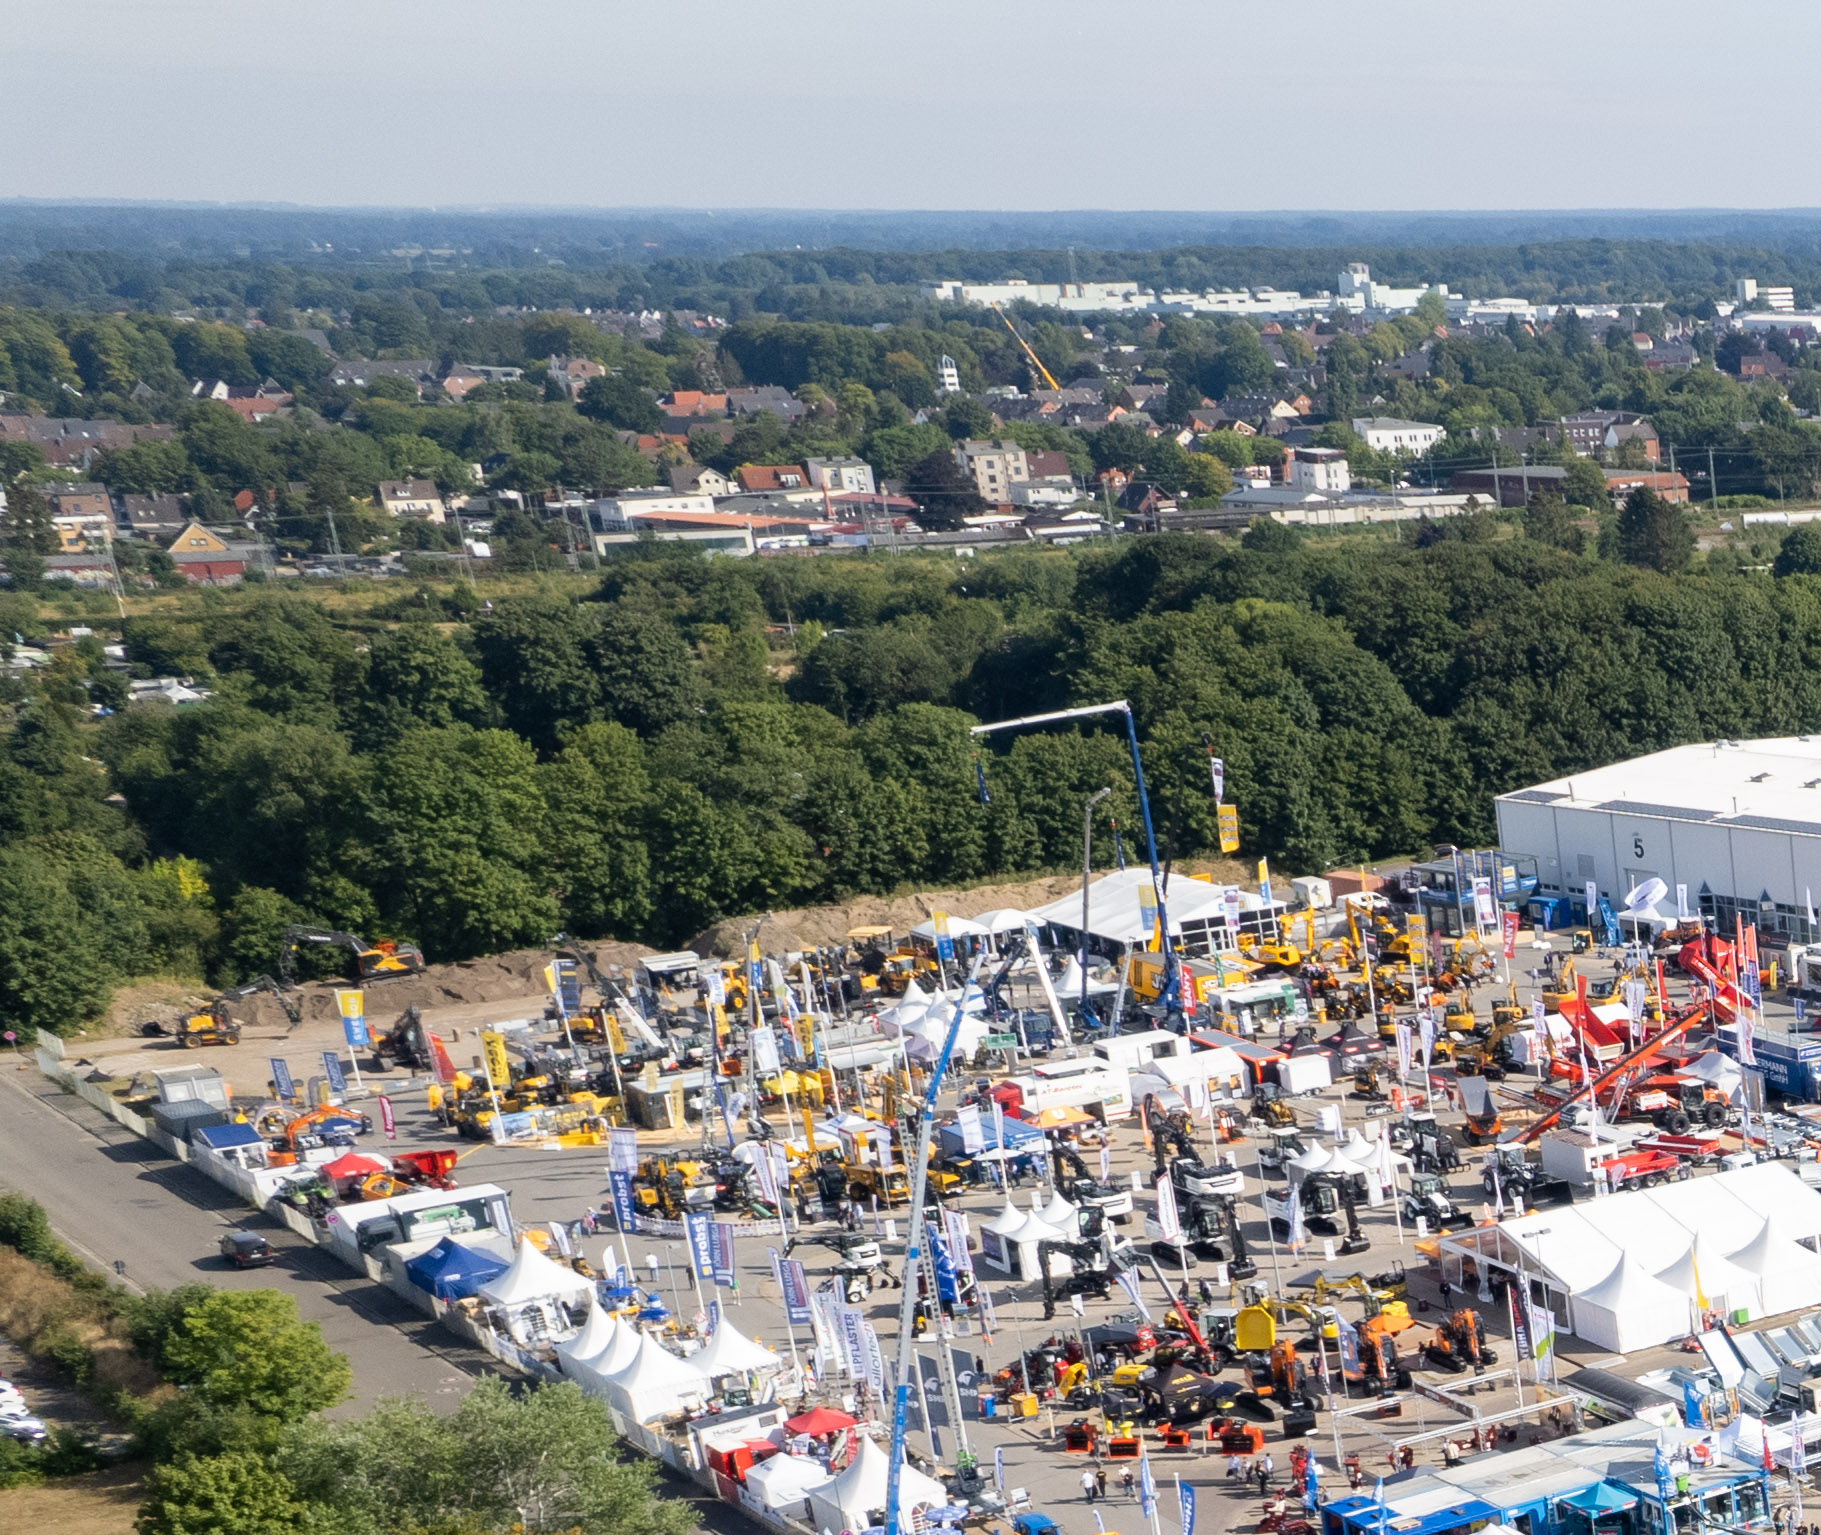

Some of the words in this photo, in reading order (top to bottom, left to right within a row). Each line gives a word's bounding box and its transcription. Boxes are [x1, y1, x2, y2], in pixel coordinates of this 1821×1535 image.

[1634, 837, 1645, 859] 5
[613, 1173, 633, 1222] probst
[691, 1215, 713, 1266] probst
